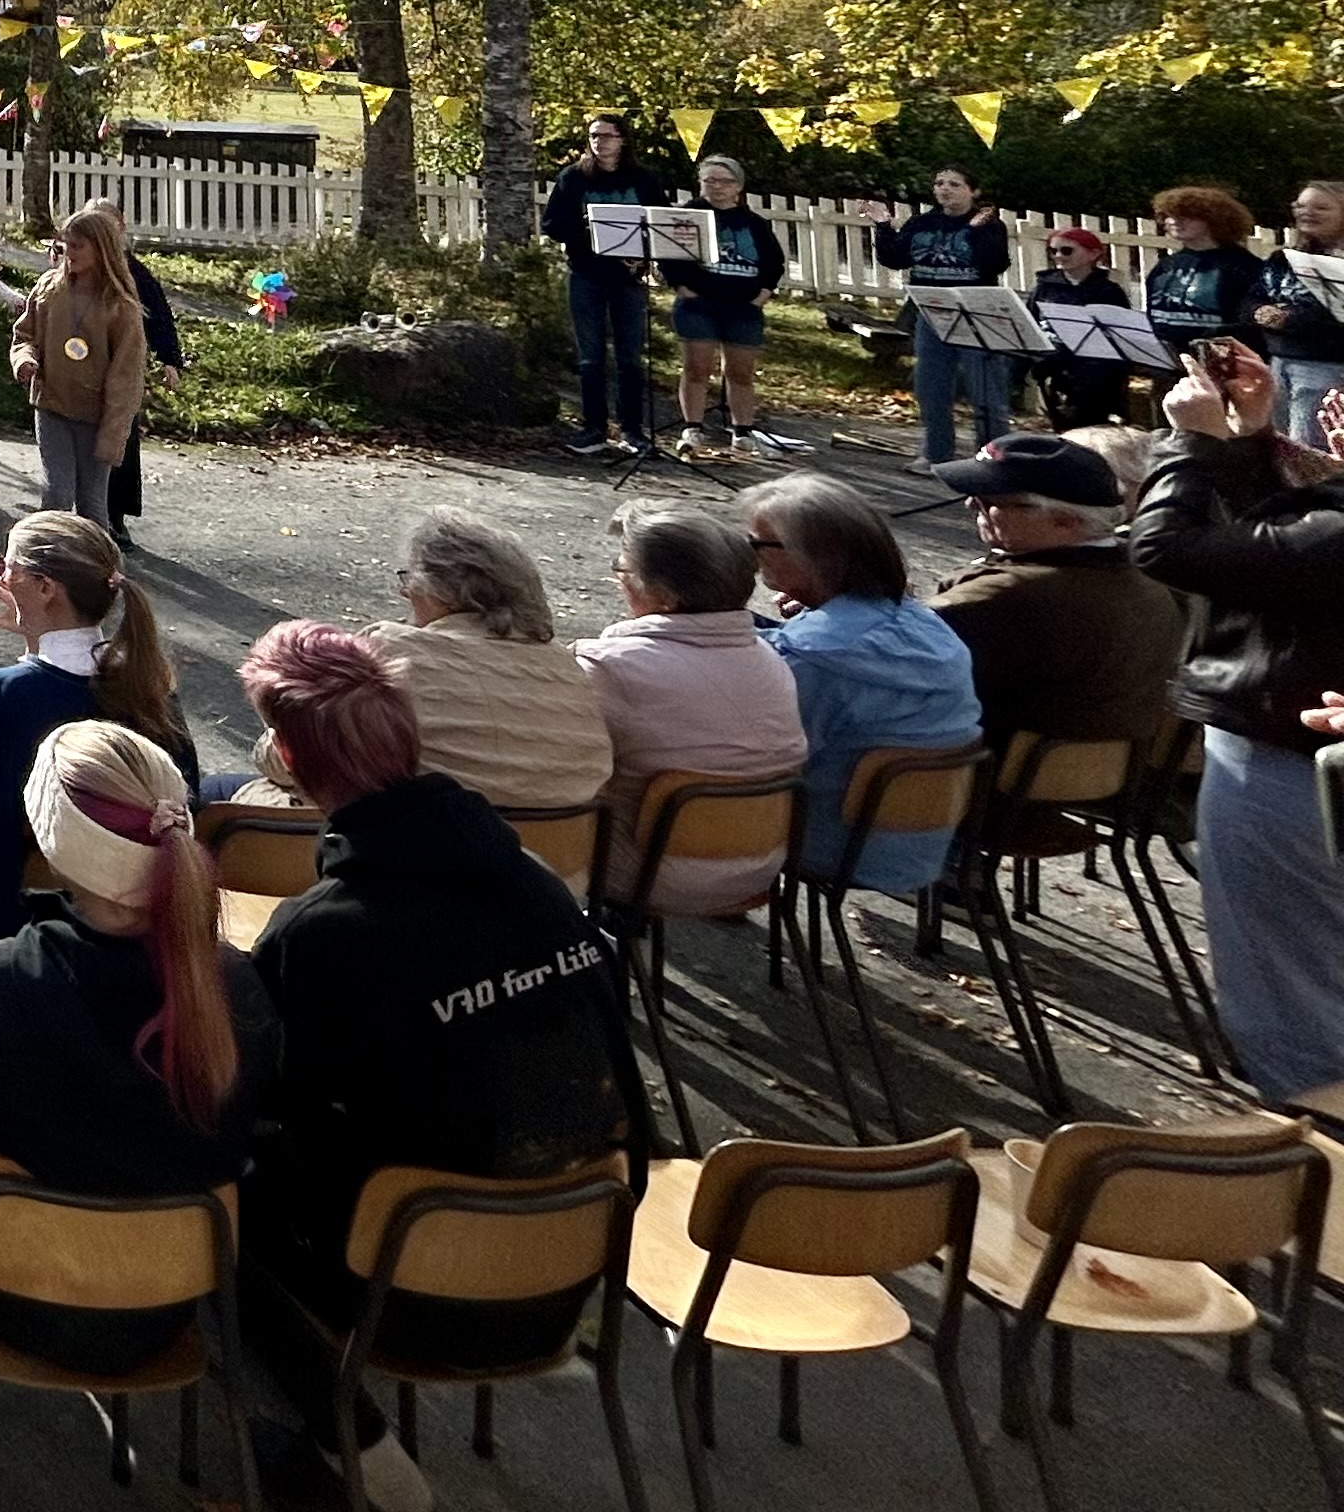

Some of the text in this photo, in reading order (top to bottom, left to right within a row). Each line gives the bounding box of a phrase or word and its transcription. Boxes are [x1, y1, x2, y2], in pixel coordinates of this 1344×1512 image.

[432, 940, 602, 1023] V70 for Life
